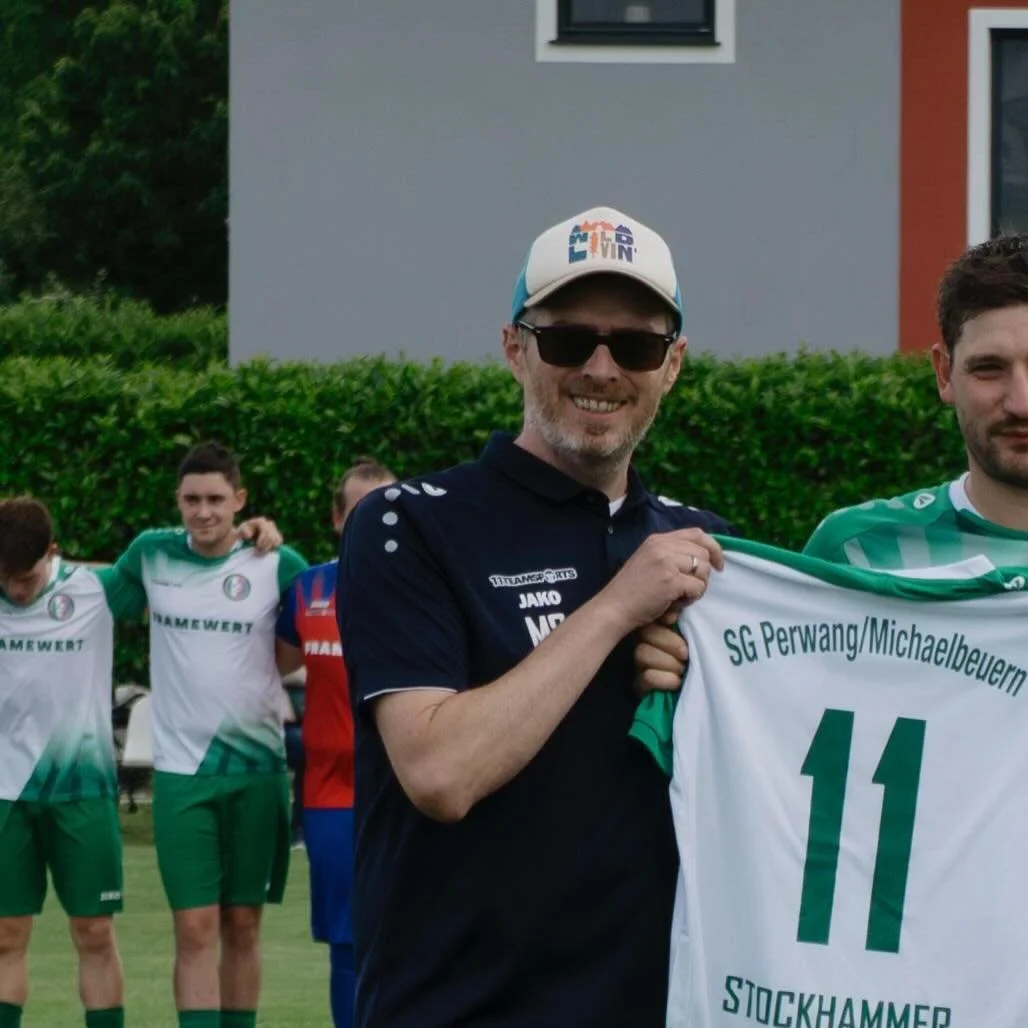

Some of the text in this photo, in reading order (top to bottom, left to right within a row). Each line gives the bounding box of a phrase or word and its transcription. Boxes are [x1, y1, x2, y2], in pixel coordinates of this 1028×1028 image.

[519, 589, 562, 609] JAKO
[723, 615, 1028, 698] SG Perwang/Michaelbeuern
[796, 708, 927, 955] 11
